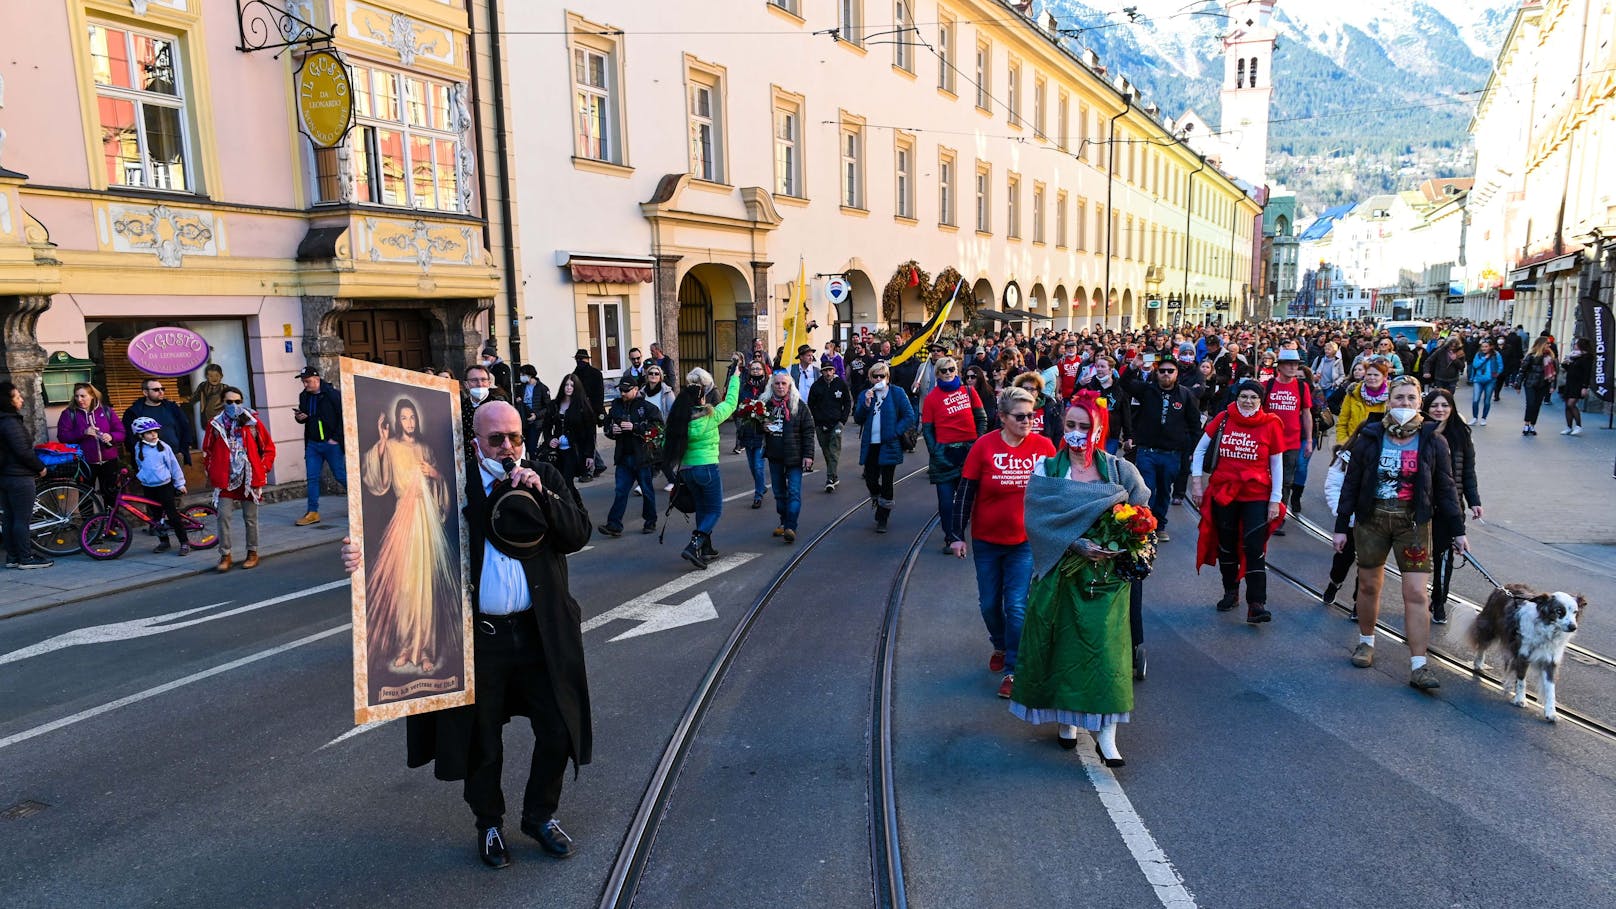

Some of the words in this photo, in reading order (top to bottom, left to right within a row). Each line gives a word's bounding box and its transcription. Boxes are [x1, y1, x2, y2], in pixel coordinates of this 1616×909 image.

[302, 81, 314, 98] IL
[309, 57, 347, 96] GUSTO
[309, 99, 342, 109] LEONARDO
[316, 130, 334, 141] SOLO
[135, 338, 154, 354] IL
[154, 332, 202, 352] GUSTO
[160, 351, 192, 359] LEONARDO
[1219, 447, 1259, 460] Mutant
